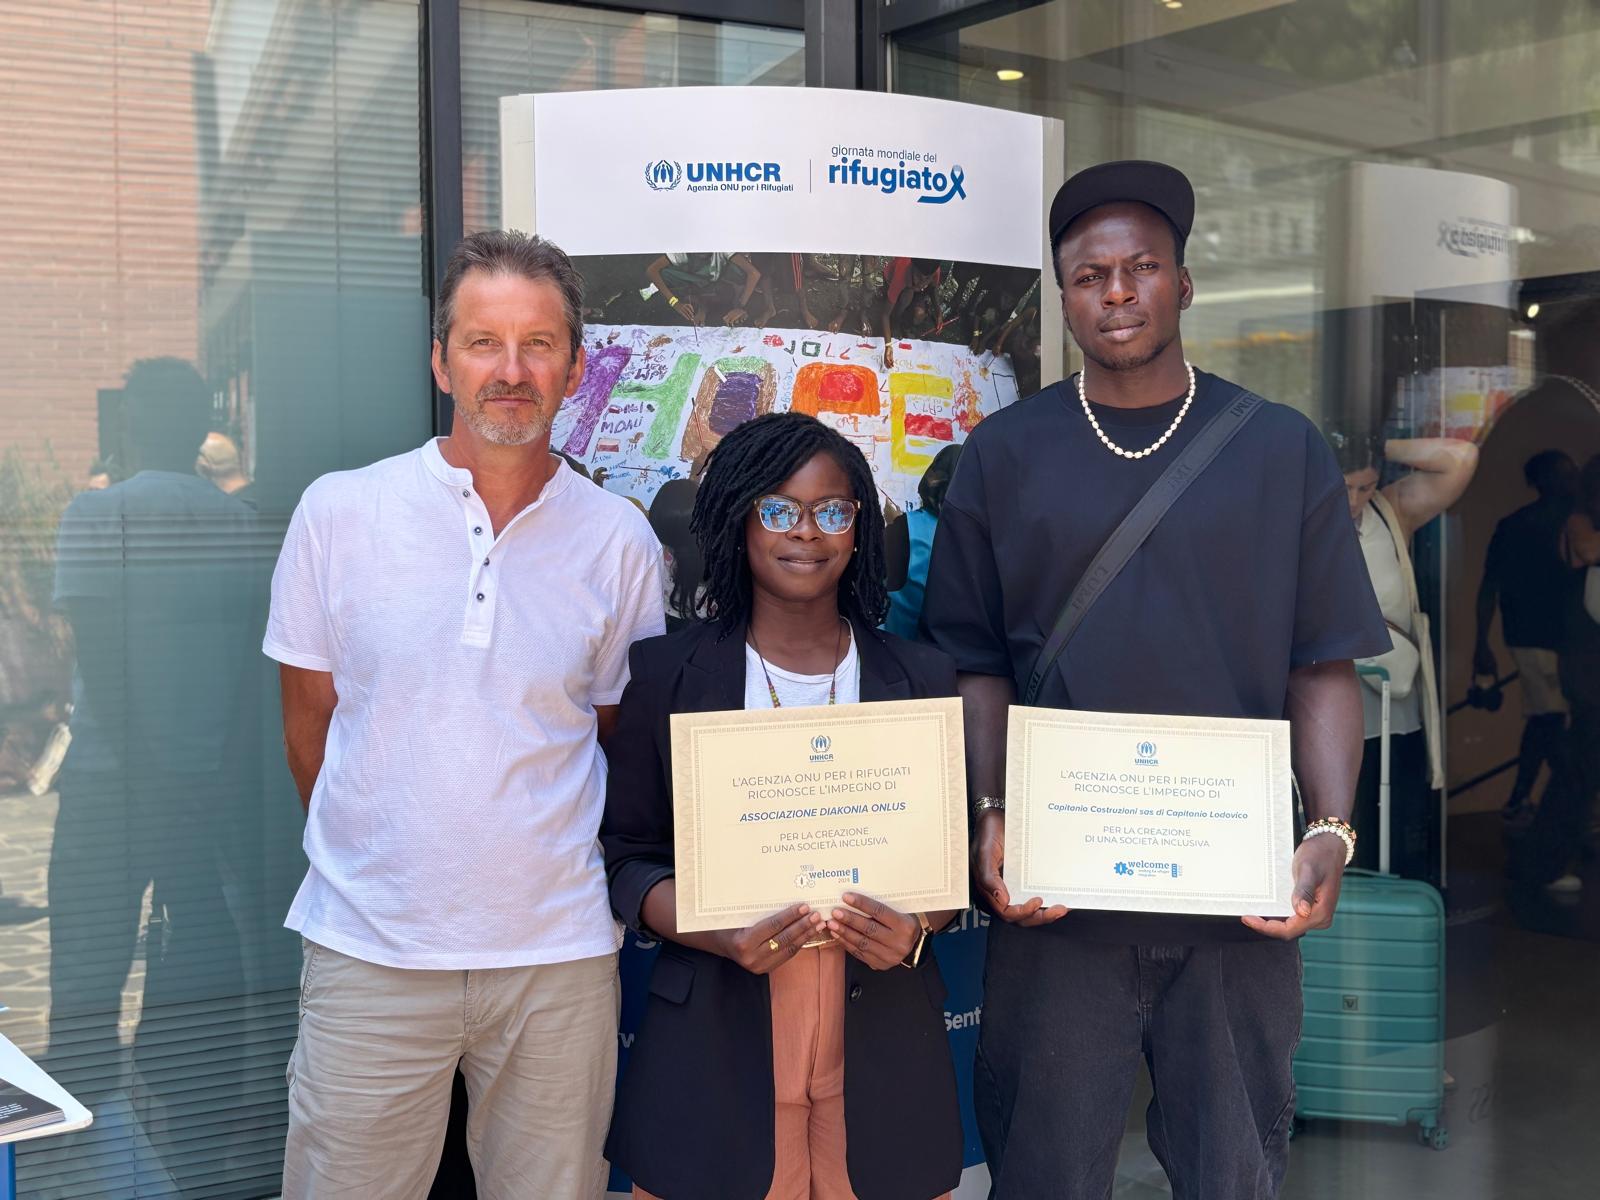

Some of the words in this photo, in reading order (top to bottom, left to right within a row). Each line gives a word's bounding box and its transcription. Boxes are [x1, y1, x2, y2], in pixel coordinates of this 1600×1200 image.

[831, 145, 874, 158] giornata
[877, 149, 921, 162] mondiale
[923, 152, 937, 163] del
[686, 162, 782, 182] UNHCR
[828, 156, 948, 194] rifugiato
[686, 184, 718, 193] Agenzia
[741, 185, 754, 193] per
[760, 184, 794, 193] Rifugiati
[732, 774, 792, 788] L'AGENZIA
[794, 772, 821, 783] ONU
[824, 770, 847, 781] PER
[856, 766, 911, 779] RIFUGIATI
[1060, 770, 1117, 782] L'AGENZIA
[1119, 773, 1145, 783] ONU
[1148, 775, 1171, 785] PER
[1180, 776, 1235, 787] RIFUGIATI
[748, 788, 816, 800] RICONOSCE
[819, 781, 882, 795] L'IMPEGNO
[884, 780, 897, 790] DI
[1074, 783, 1140, 795] RICONOSCE
[1143, 787, 1206, 798] L'IMPEGNO
[1208, 789, 1221, 799] DI
[740, 808, 817, 823] ASSOCIAZIONE
[819, 804, 869, 817] DIAKONIA
[871, 801, 906, 813] ONLUS
[1048, 802, 1088, 813] Capitanio
[1090, 805, 1138, 815] Costruzioni
[1139, 808, 1154, 816] sas
[1156, 808, 1164, 816] di
[1166, 809, 1208, 819] Capitanio
[1209, 811, 1249, 819] Lodovico
[779, 832, 799, 842] PER
[801, 831, 814, 840] LA
[815, 827, 870, 840] CREAZIONE
[1103, 825, 1121, 834] PER
[1123, 826, 1136, 835] LA
[1137, 827, 1191, 837] CREAZIONE
[761, 845, 772, 854] DI
[774, 843, 796, 853] UNA
[797, 839, 838, 852] SOCIETÀ
[839, 836, 888, 848] INCLUSIVA
[1085, 834, 1095, 843] DI
[1097, 835, 1118, 844] UNA
[1119, 836, 1159, 846] SOCIETÀ
[1161, 838, 1210, 848] INCLUSIVA
[1127, 860, 1170, 869] welcome
[808, 869, 851, 879] welcome
